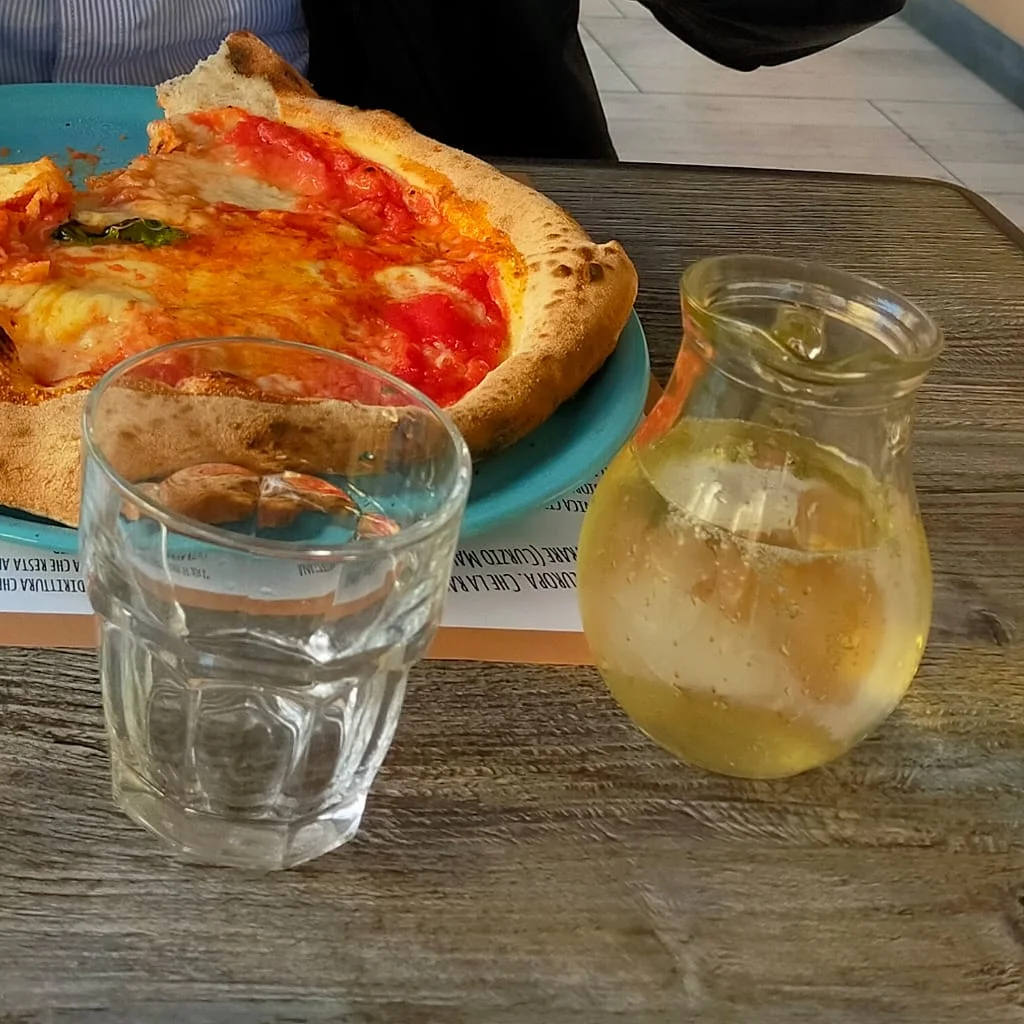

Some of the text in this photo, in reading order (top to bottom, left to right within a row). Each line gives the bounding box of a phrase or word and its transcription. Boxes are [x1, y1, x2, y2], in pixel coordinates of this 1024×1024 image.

[480, 545, 546, 567] (CURZIO
[13, 558, 48, 572] RESTA
[50, 559, 71, 572] CHE
[466, 575, 490, 592] LA
[486, 573, 521, 593] CHE
